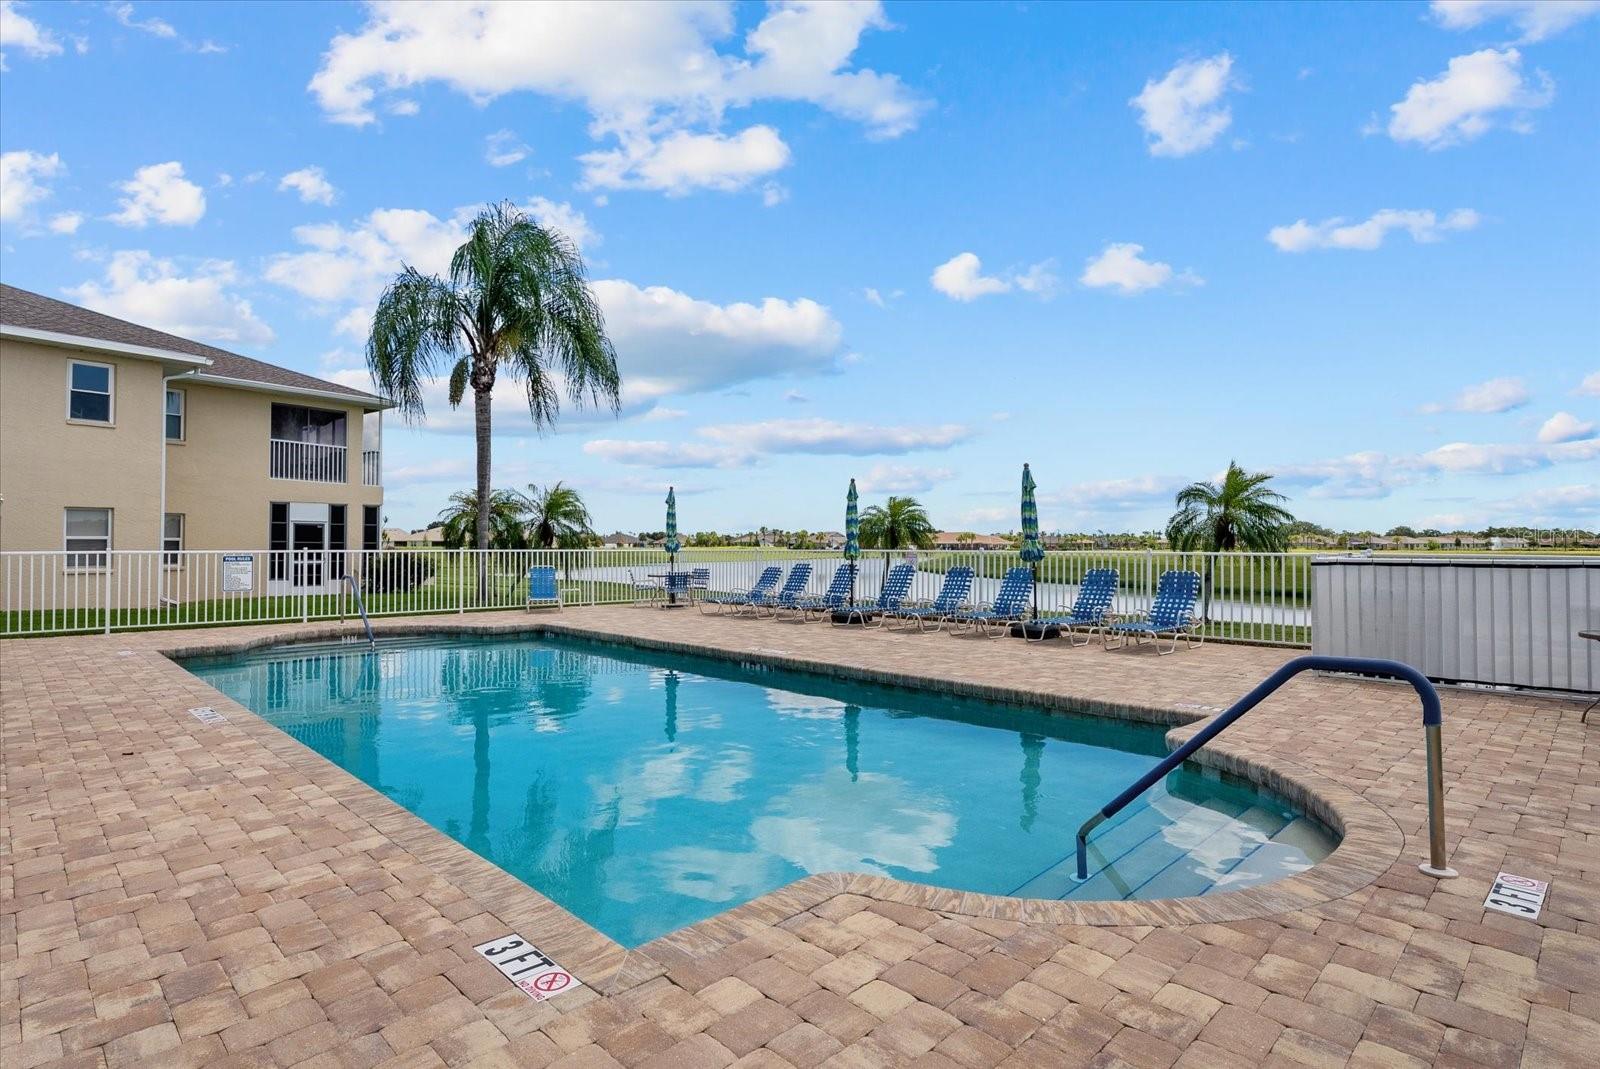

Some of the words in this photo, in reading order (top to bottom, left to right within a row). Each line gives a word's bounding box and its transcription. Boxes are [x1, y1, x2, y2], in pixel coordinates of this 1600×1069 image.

[1492, 882, 1541, 904] FT
[1489, 898, 1537, 914] 3
[484, 940, 524, 956] 3
[498, 949, 556, 977] FT
[525, 986, 546, 1001] DIVING
